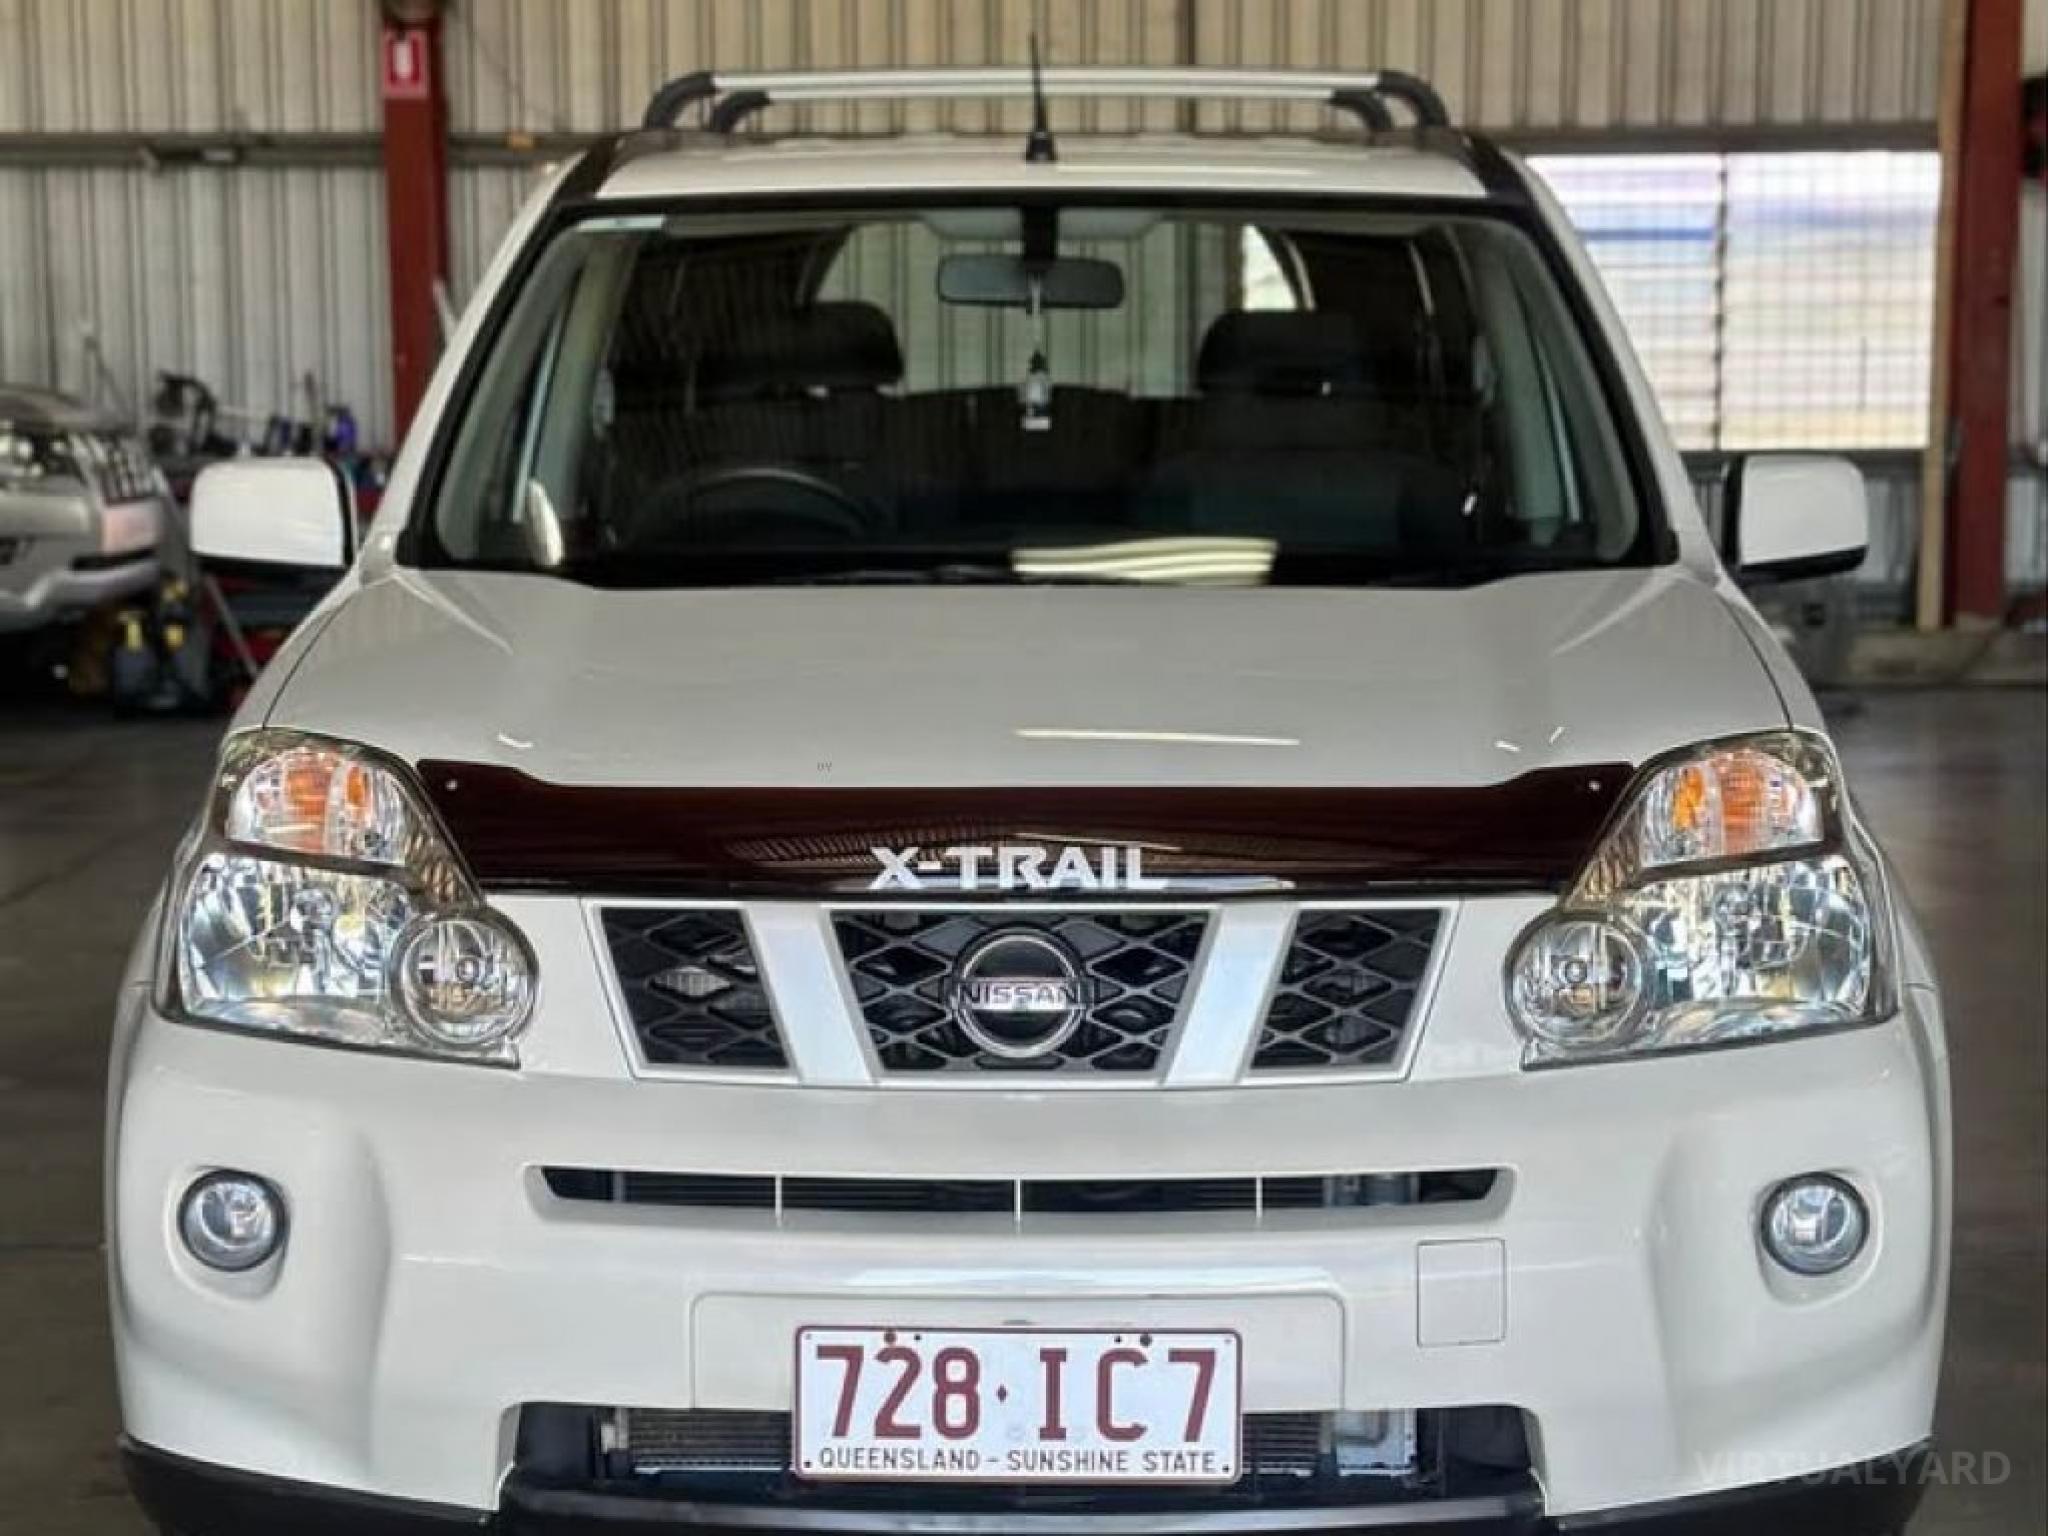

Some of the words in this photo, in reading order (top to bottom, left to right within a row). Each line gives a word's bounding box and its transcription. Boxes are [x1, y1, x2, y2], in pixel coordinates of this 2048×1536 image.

[865, 846, 1171, 889] X-TRAIL
[957, 982, 1080, 1009] NISSAN
[818, 1446, 980, 1470] QUEENSLAND
[1006, 1449, 1129, 1472] SUNSHINE
[1141, 1451, 1217, 1473] STATE
